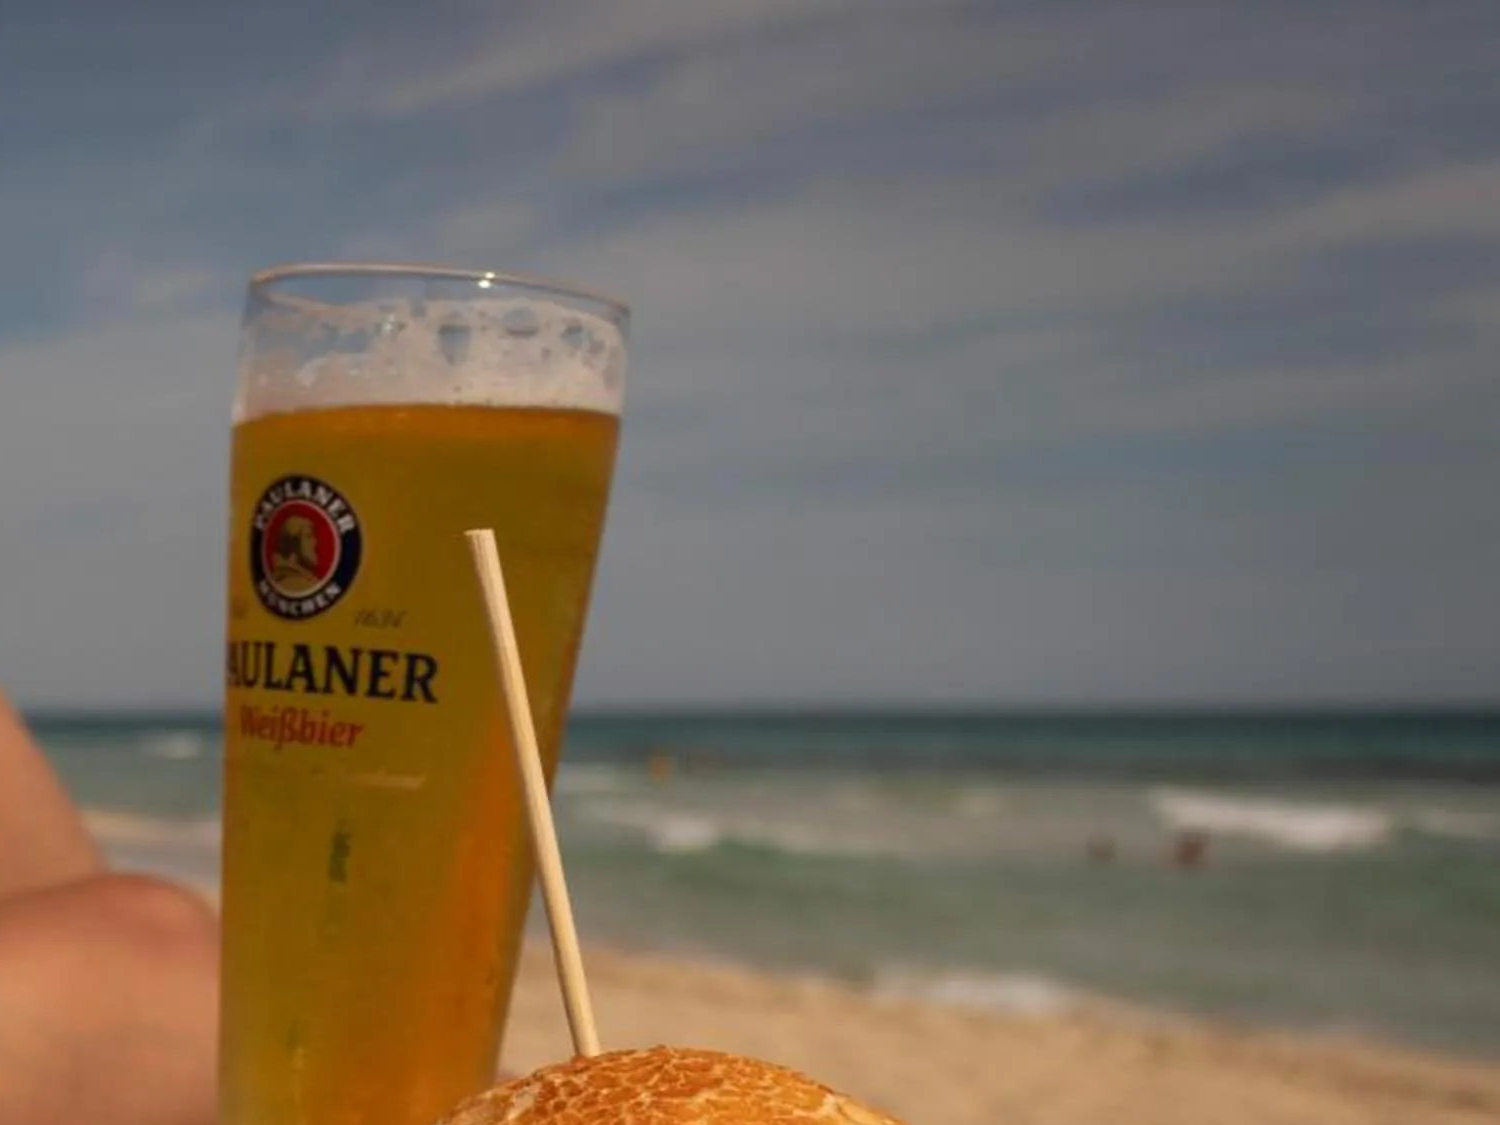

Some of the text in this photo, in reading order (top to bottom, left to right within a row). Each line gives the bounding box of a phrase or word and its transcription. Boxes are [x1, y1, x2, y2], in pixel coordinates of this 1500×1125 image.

[255, 480, 356, 533] PAULANER
[228, 640, 439, 704] AULANER
[240, 704, 363, 750] Weißbier
